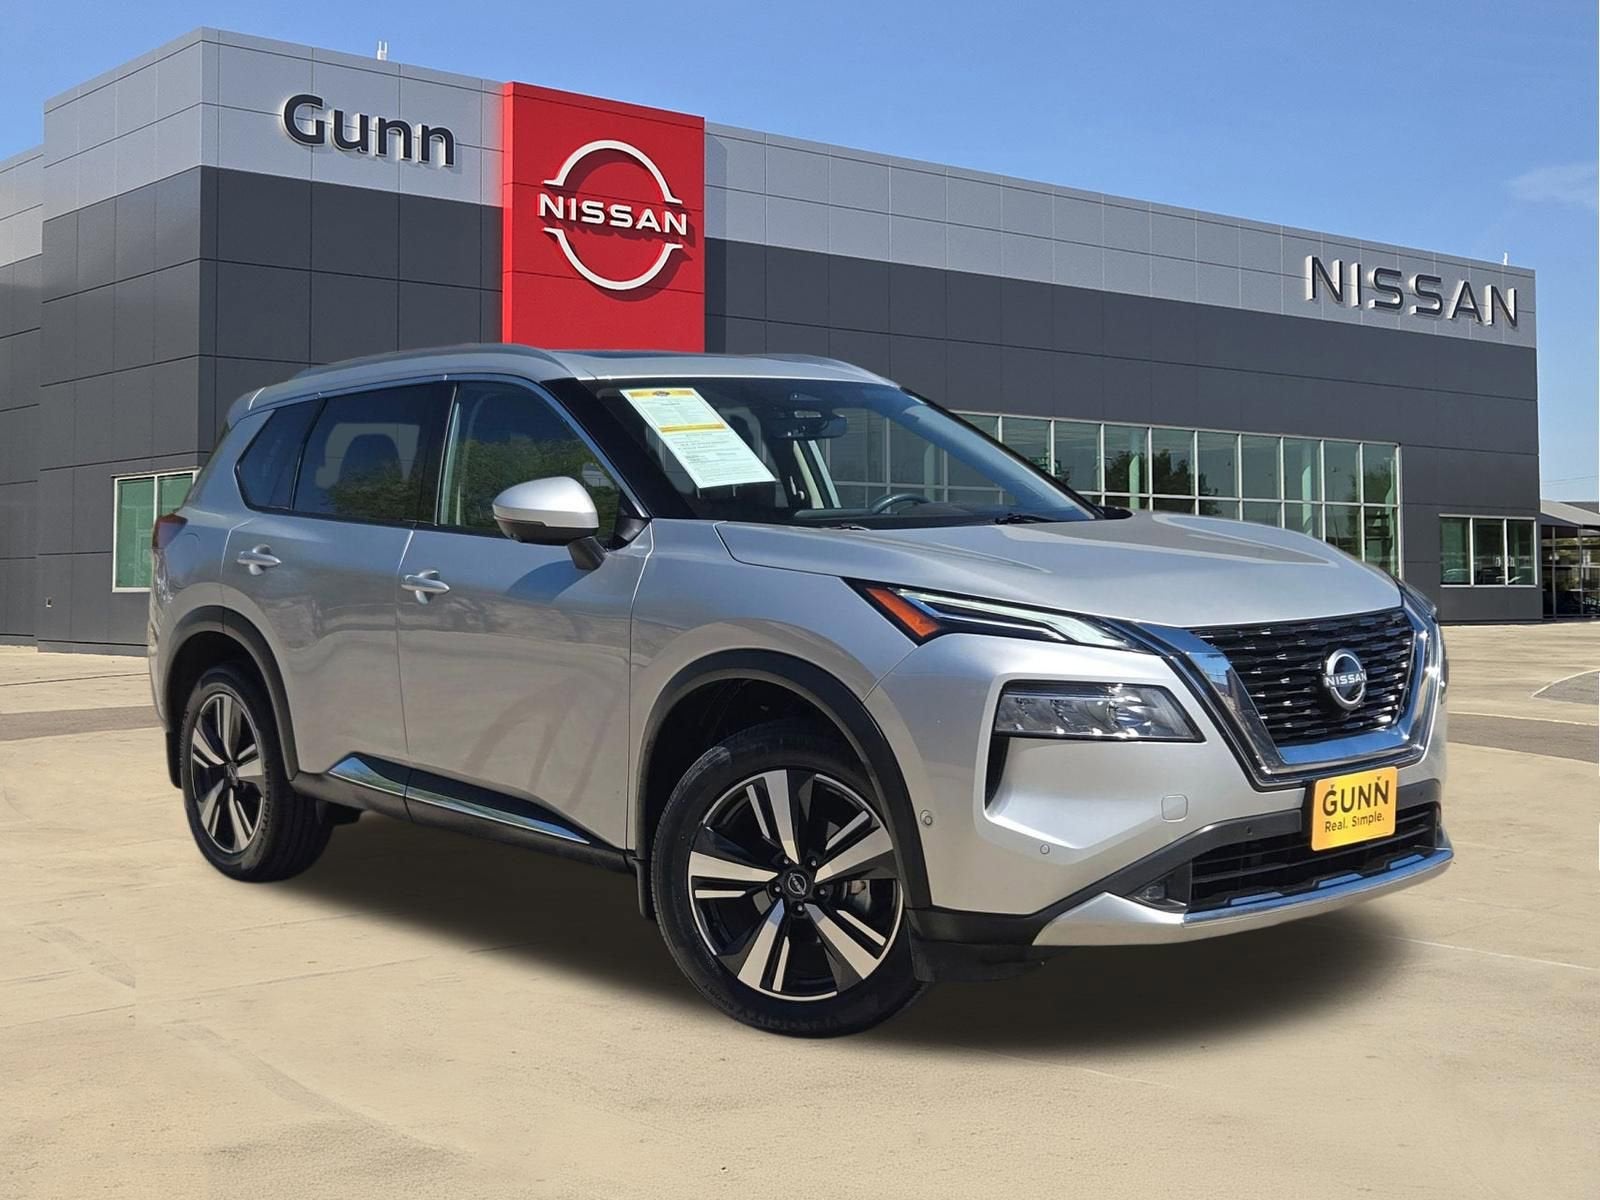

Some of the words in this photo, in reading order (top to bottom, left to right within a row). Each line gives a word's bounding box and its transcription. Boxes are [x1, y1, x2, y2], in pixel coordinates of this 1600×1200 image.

[282, 94, 455, 167] Gunn
[537, 193, 687, 235] NISSAN
[1305, 255, 1518, 328] NISSAN
[1324, 669, 1367, 687] NISSAN
[1322, 780, 1389, 816] GUNN
[1325, 817, 1348, 833] Real.
[1352, 811, 1385, 827] Simple.
